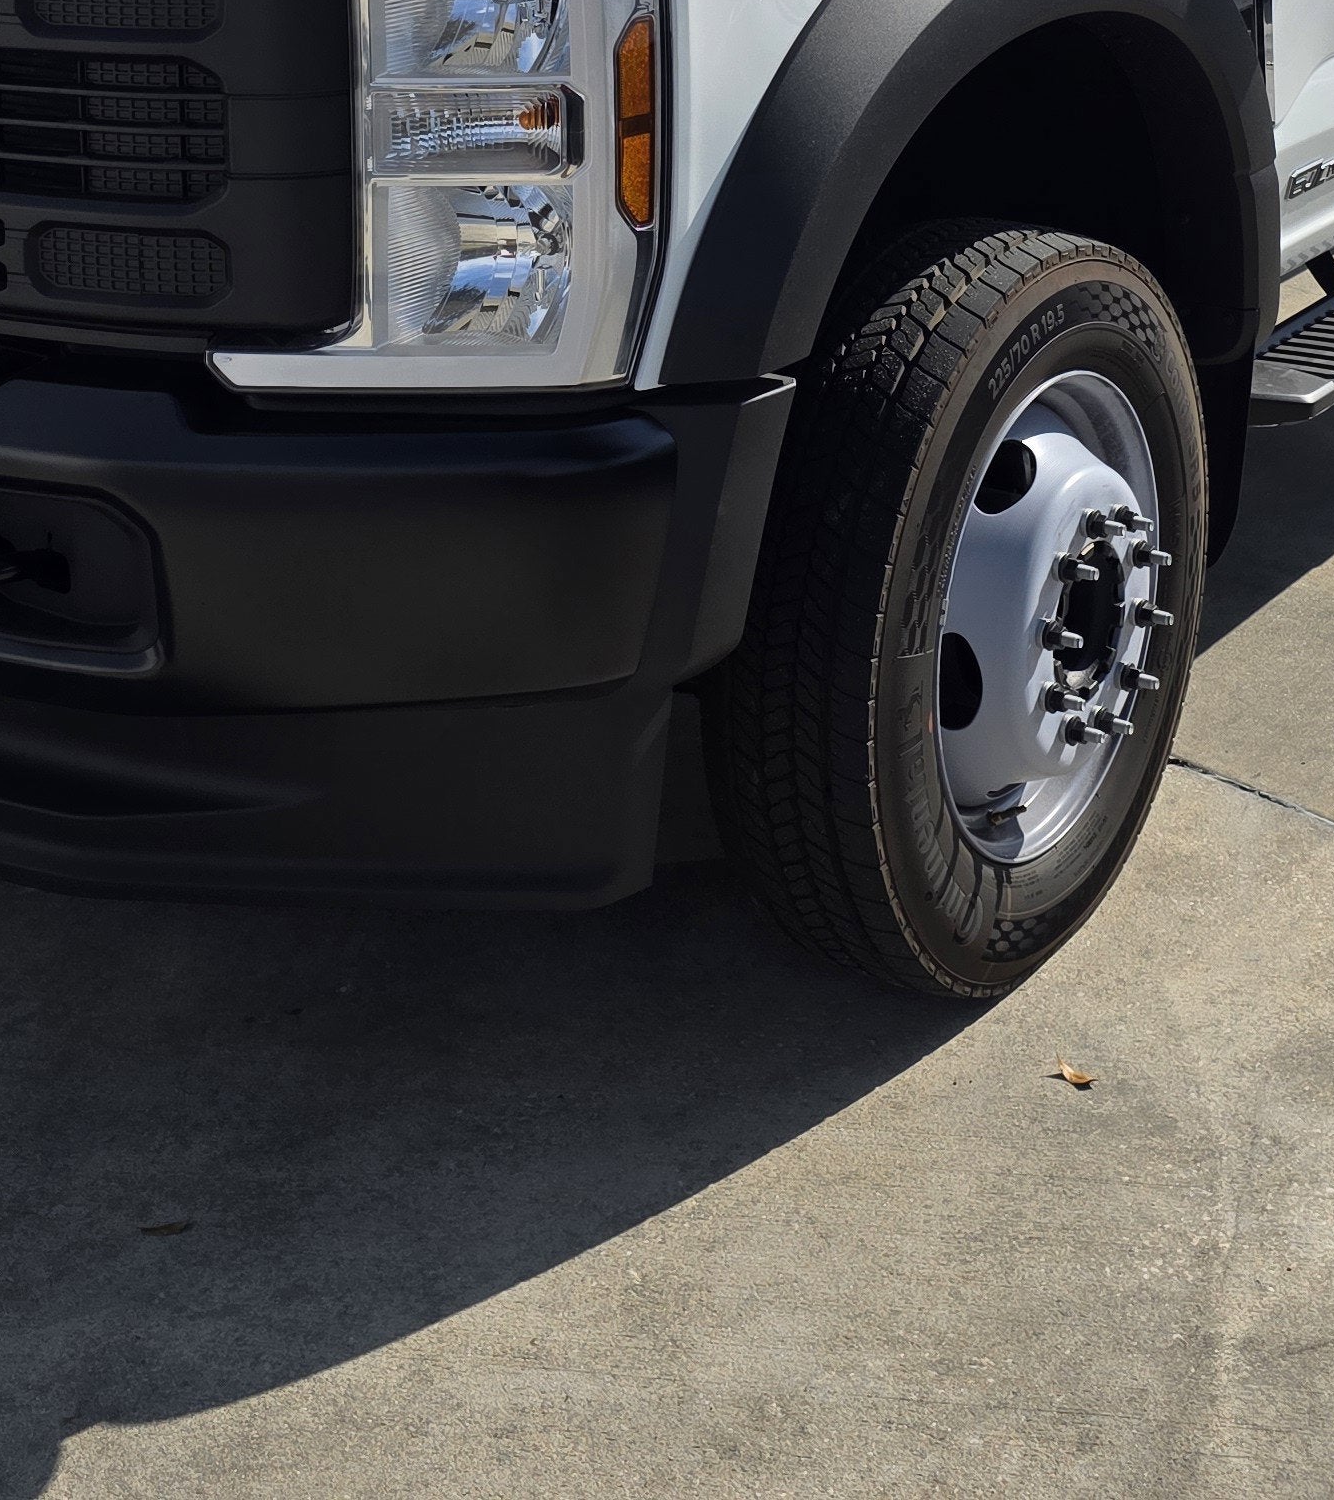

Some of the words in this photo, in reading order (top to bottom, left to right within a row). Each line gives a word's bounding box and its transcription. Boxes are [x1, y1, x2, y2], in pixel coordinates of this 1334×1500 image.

[988, 334, 1031, 400] 225/70
[1029, 323, 1041, 341] R
[1040, 303, 1066, 336] 19.5
[898, 733, 983, 946] Continental
